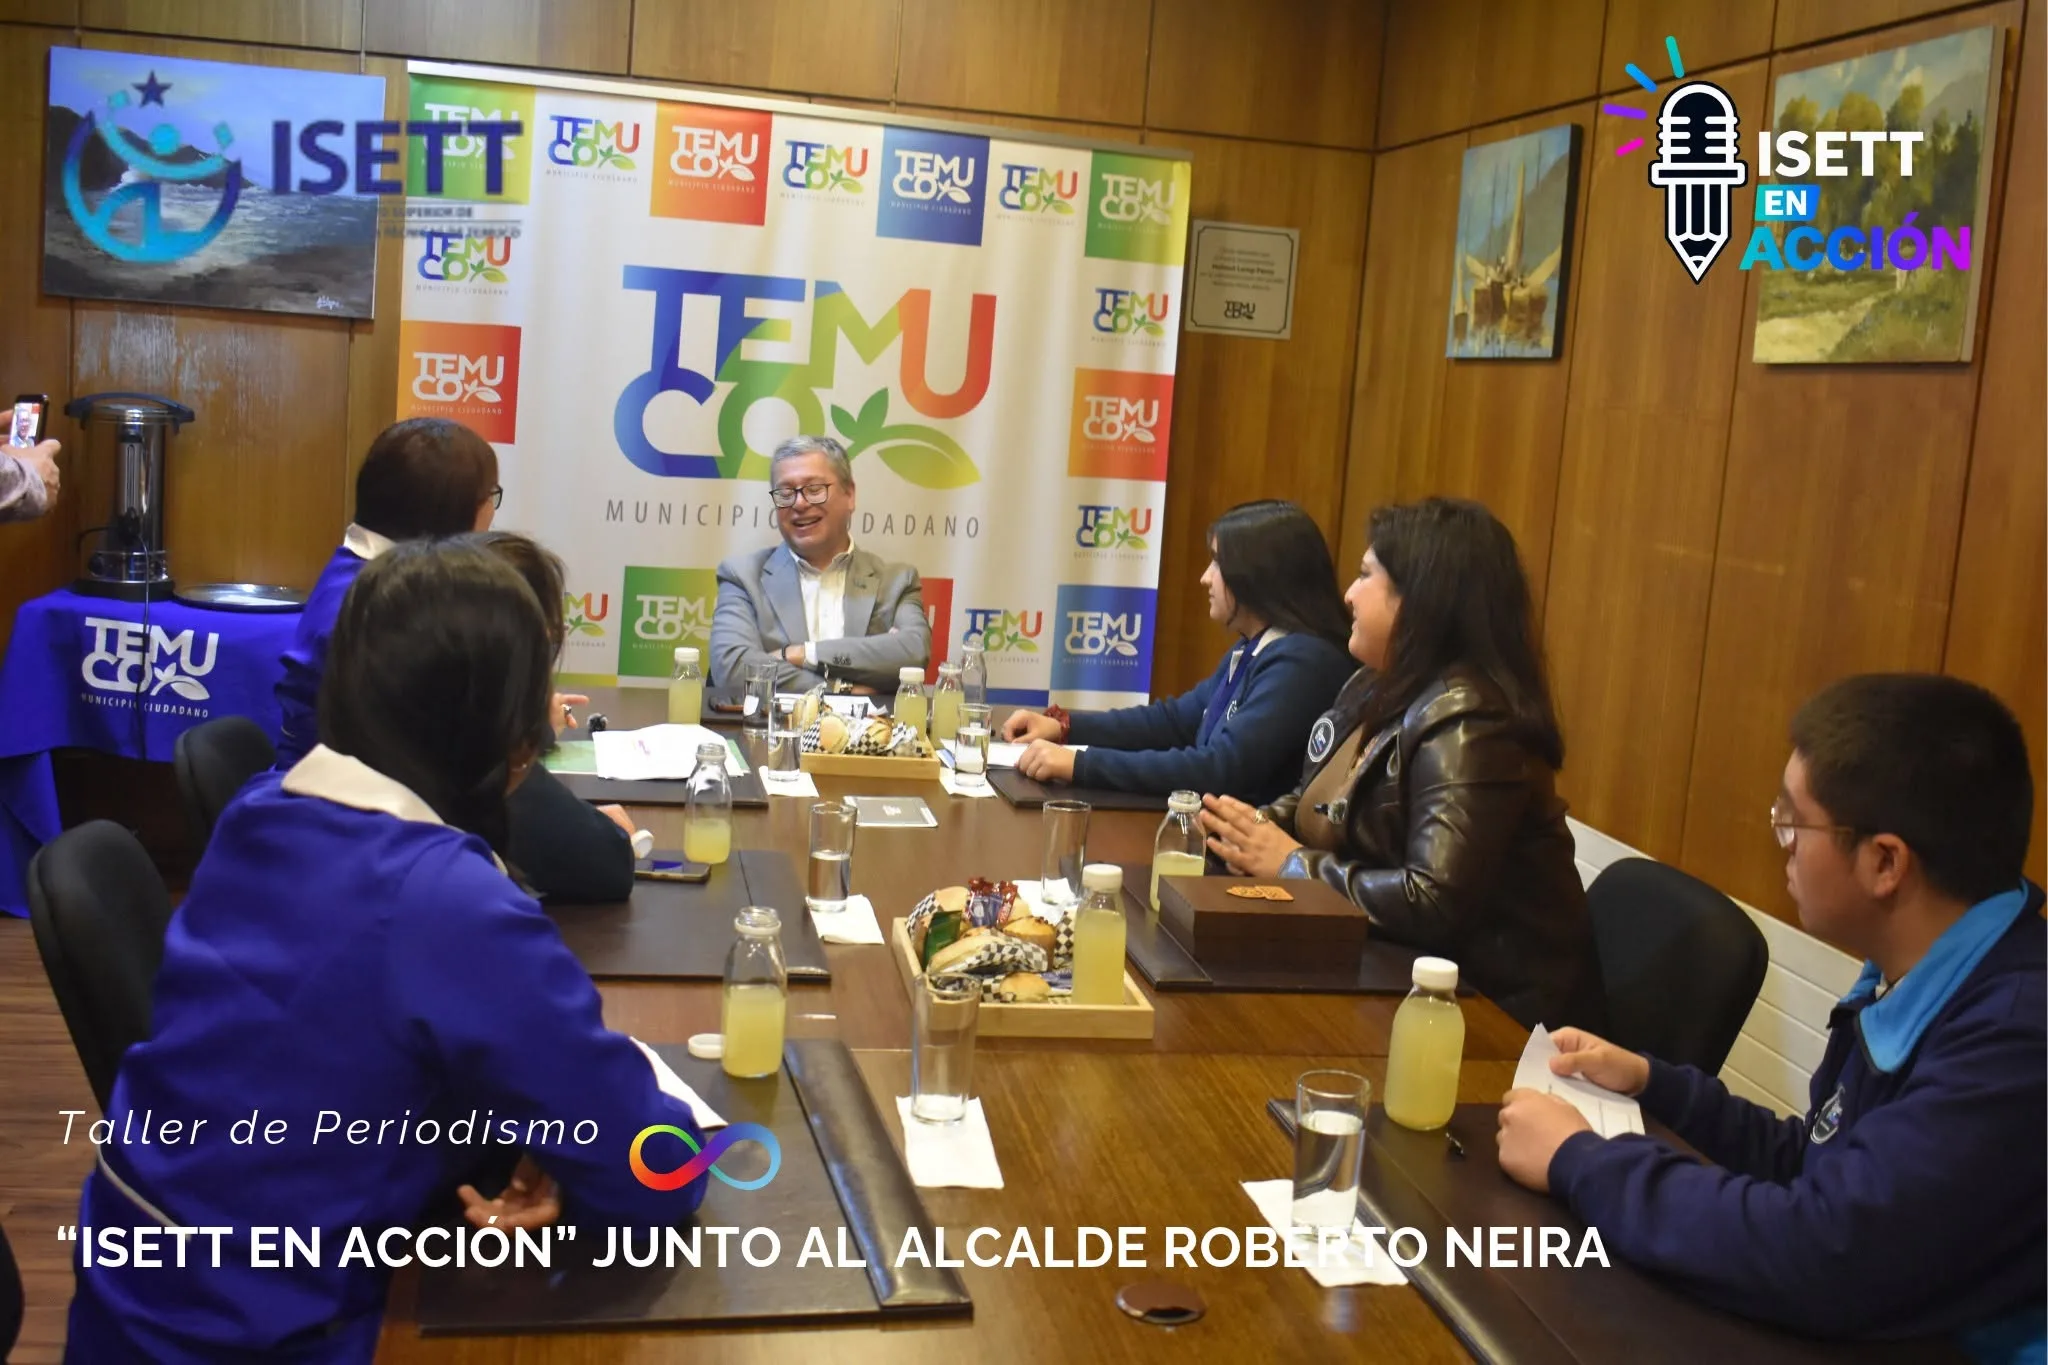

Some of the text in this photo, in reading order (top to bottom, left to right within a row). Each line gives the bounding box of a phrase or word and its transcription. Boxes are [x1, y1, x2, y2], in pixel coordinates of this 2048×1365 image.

[622, 264, 997, 419] TEMU
[564, 592, 608, 621] MU
[85, 616, 219, 676] TEMU
